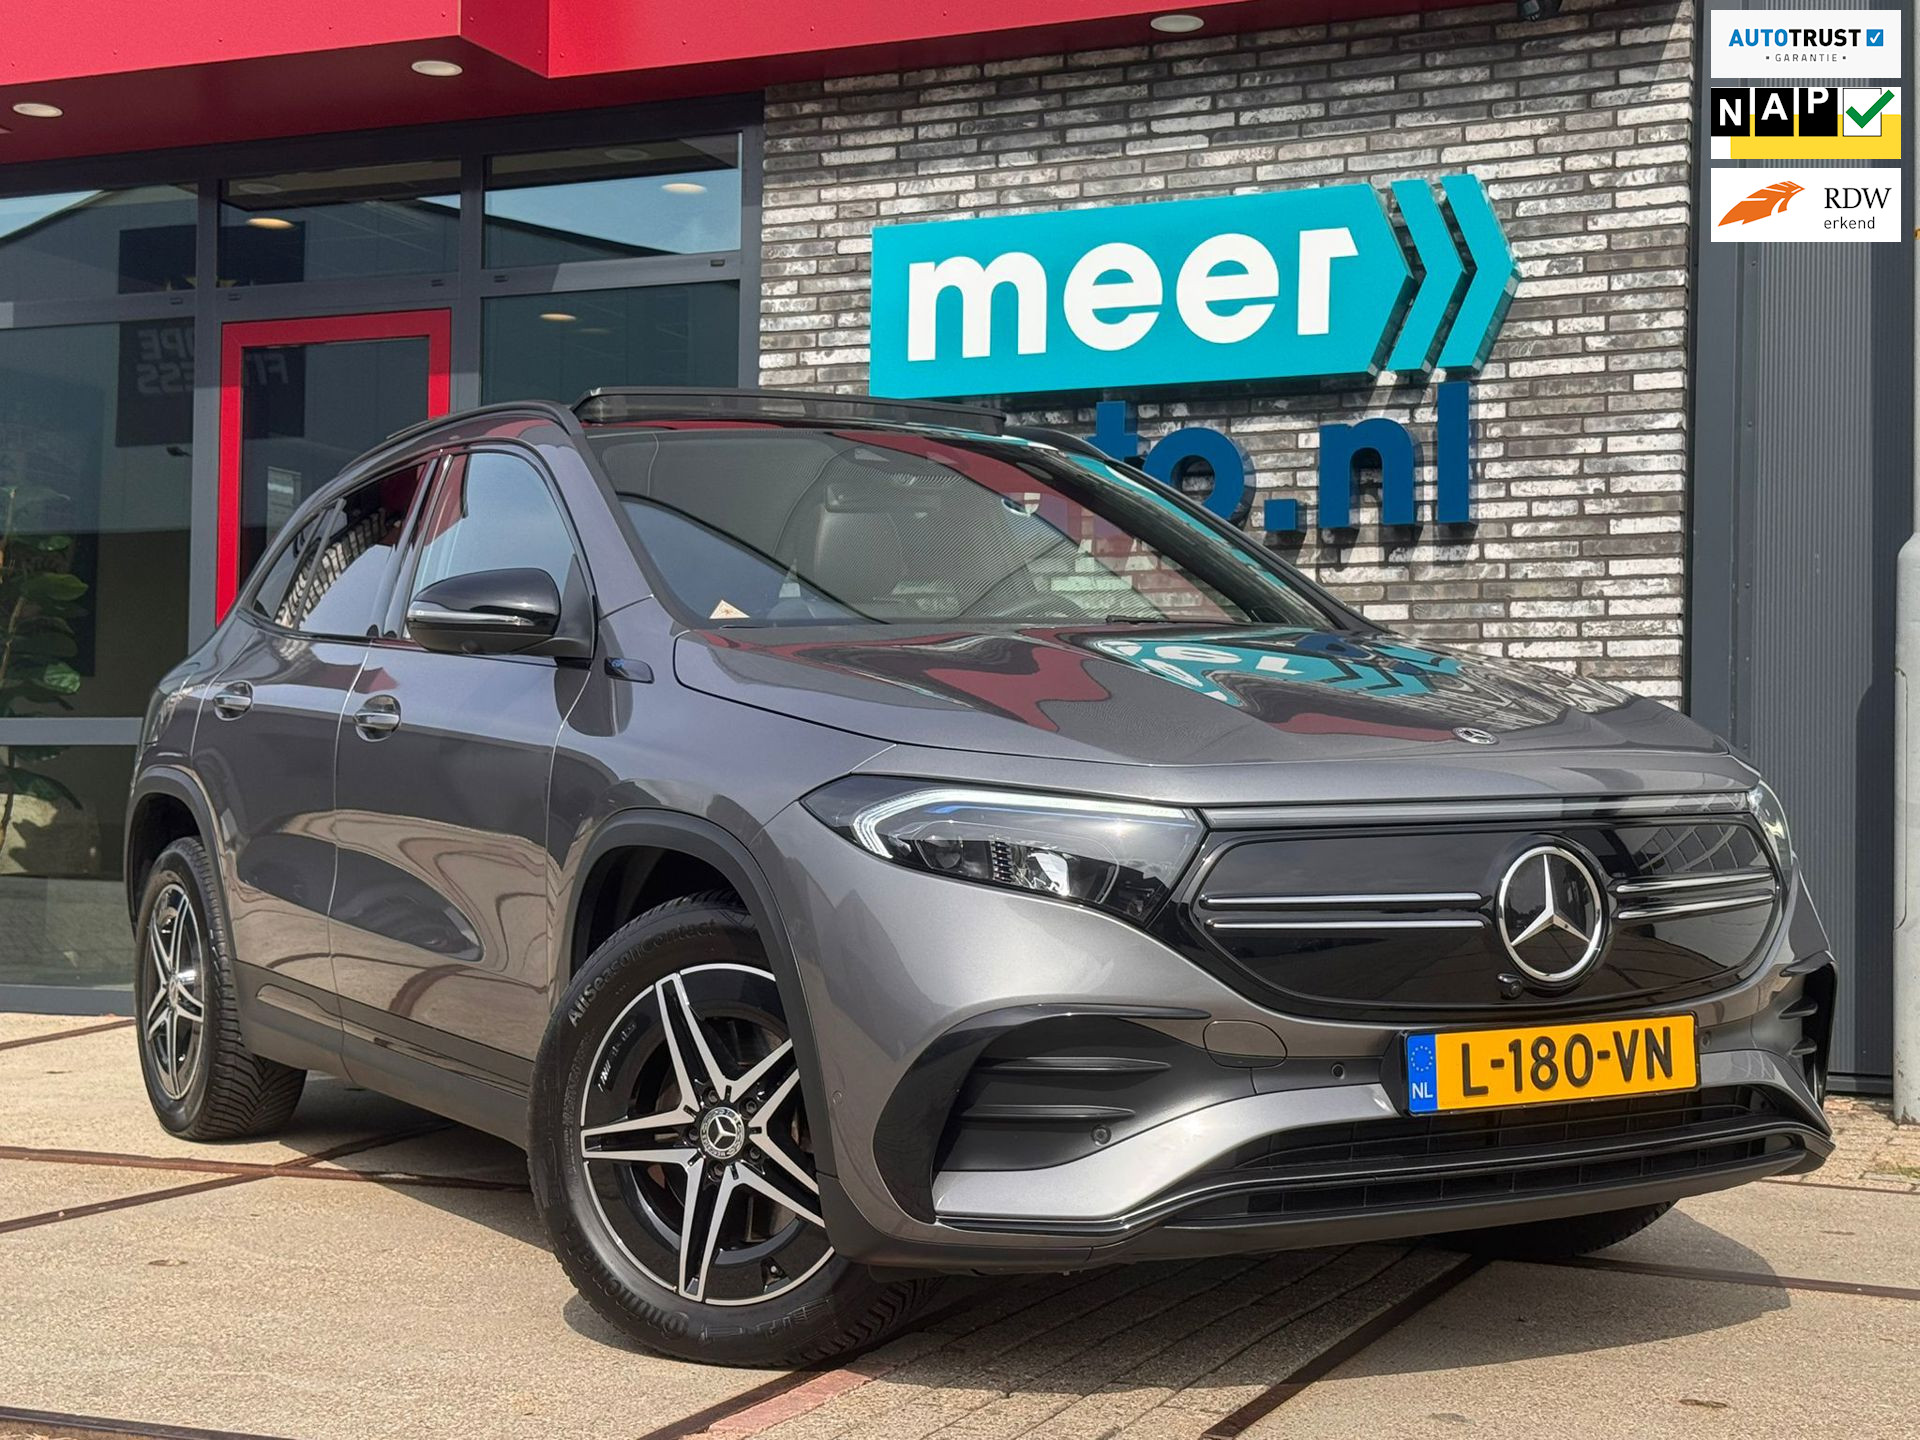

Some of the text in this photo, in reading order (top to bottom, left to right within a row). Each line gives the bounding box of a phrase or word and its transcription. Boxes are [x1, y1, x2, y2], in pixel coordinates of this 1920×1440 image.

[906, 226, 1359, 362] meer
[1411, 1082, 1434, 1099] NL
[1461, 1026, 1673, 1097] L-180-VN
